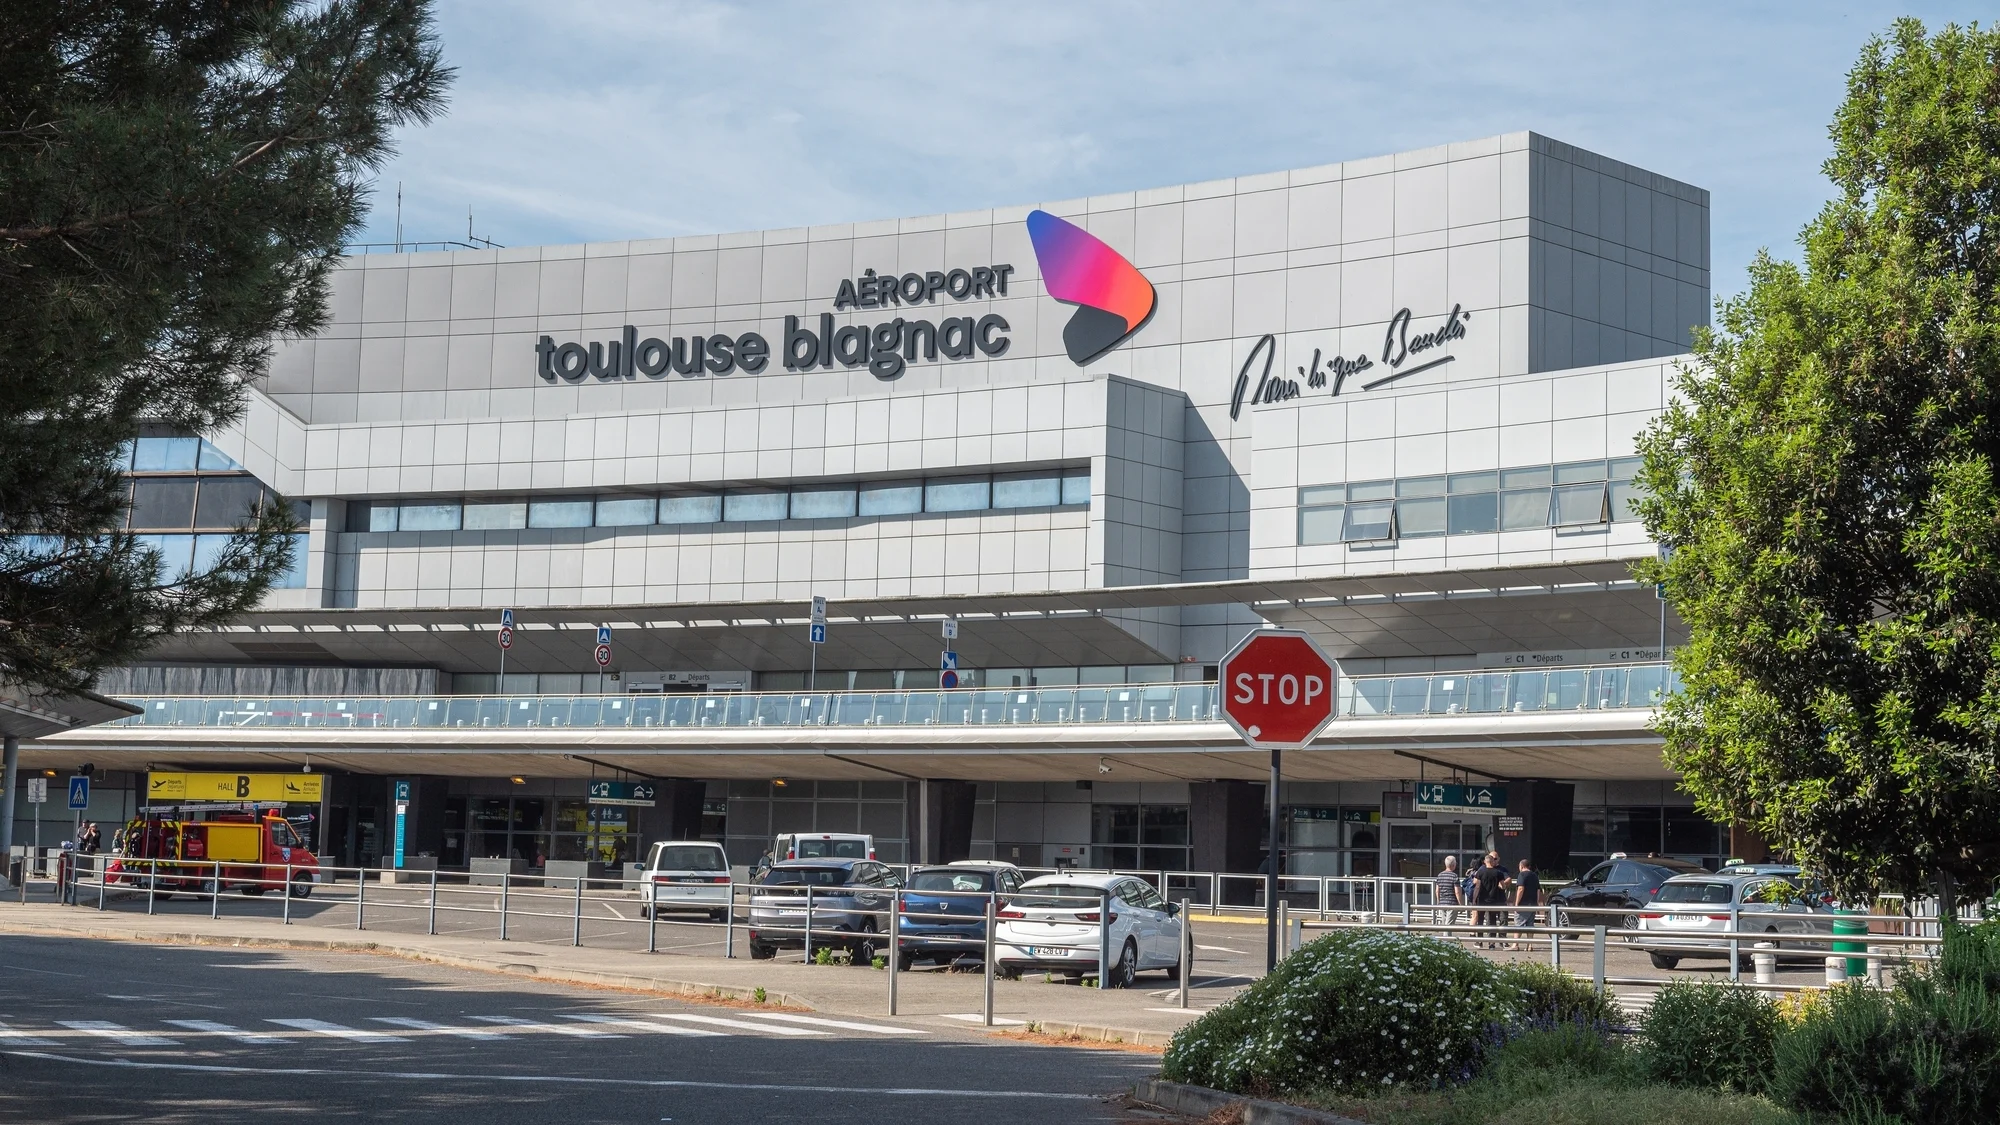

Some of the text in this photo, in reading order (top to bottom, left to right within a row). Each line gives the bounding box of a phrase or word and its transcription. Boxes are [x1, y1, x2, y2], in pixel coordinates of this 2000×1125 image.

[833, 263, 1014, 310] AÉROPORT
[536, 311, 1011, 384] toulouse blagnac
[501, 633, 511, 643] 30
[599, 651, 608, 661] 30
[1536, 654, 1563, 663] Départs
[1621, 650, 1667, 660] C1 Dépars
[688, 673, 710, 682] Départs
[1234, 672, 1324, 706] STOP
[217, 775, 250, 798] HALL B
